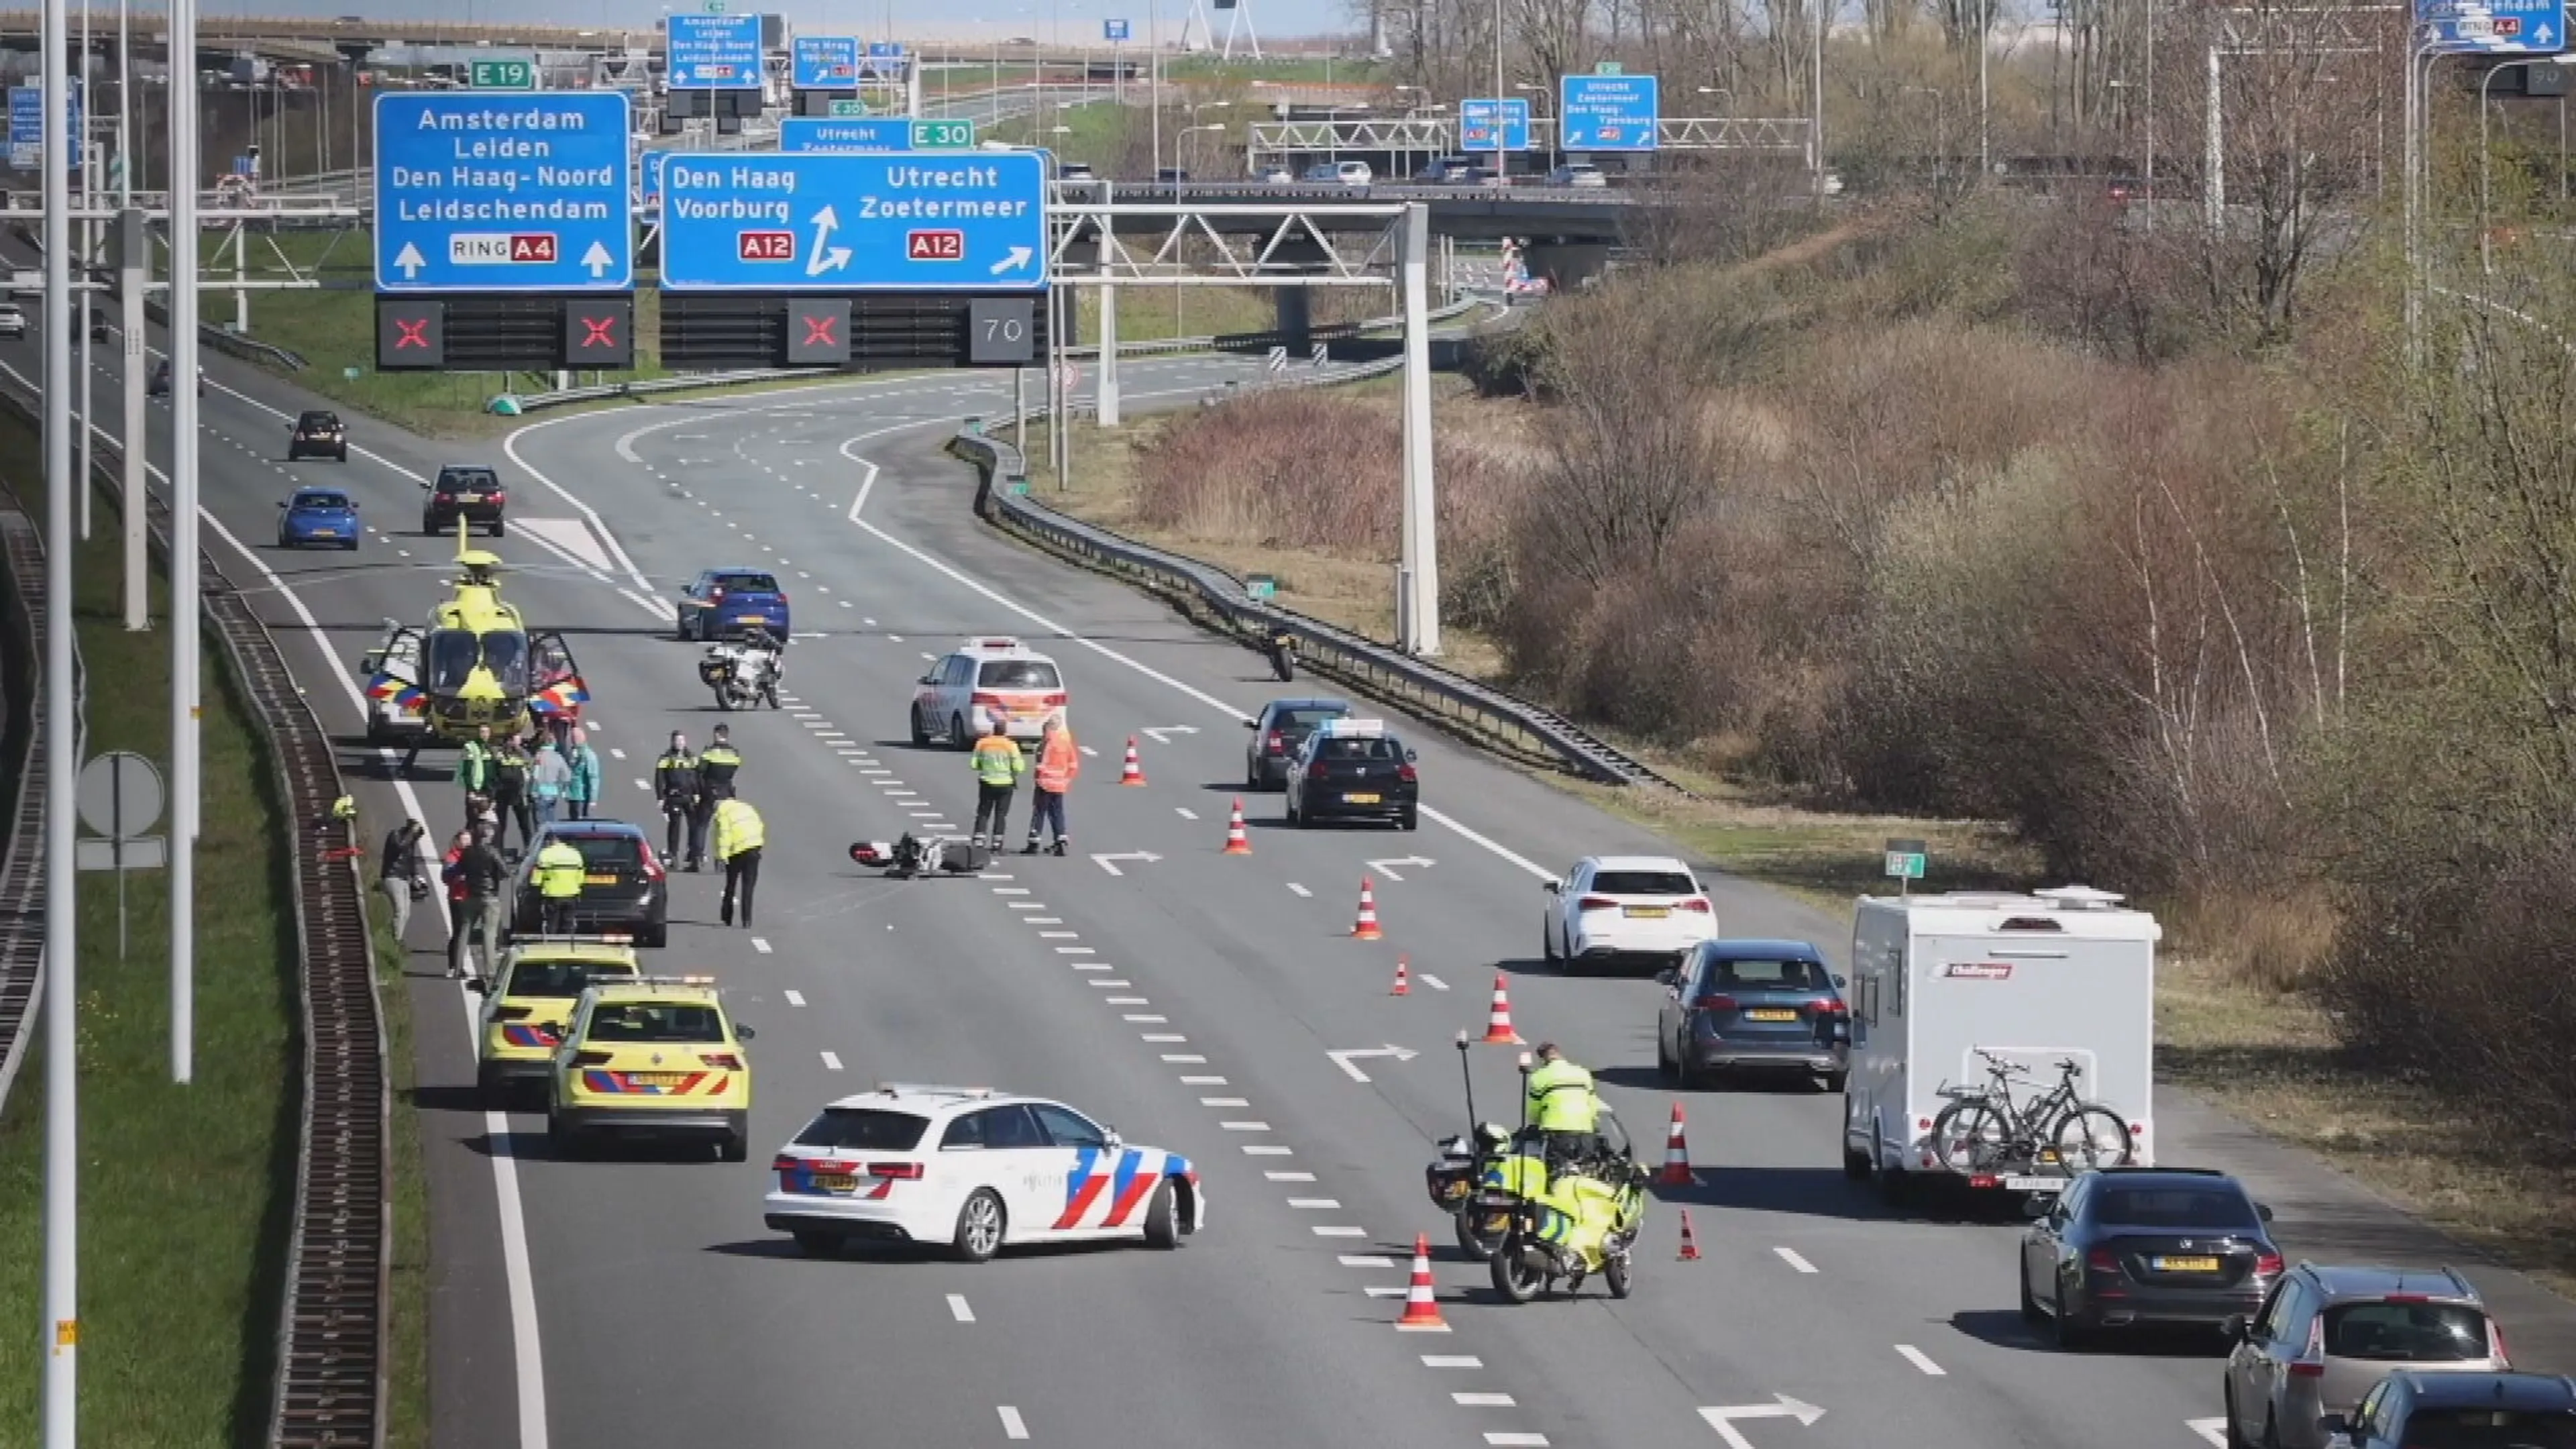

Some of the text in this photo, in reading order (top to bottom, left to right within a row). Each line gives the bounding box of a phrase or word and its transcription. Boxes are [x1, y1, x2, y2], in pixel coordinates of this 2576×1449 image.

[2496, 21, 2516, 32] A4
[478, 64, 523, 84] E 19
[419, 108, 584, 129] Amsterdam
[817, 128, 875, 140] Utrecht
[914, 126, 968, 144] E 30
[455, 138, 549, 157] Leiden
[393, 166, 441, 187] Den
[674, 168, 721, 189] Den
[732, 168, 796, 194] Haag
[888, 167, 998, 188] Utrecht
[400, 199, 608, 221] Leidschendam
[674, 199, 790, 222] Voorburg
[860, 197, 1027, 217] Zoetermeer
[454, 239, 551, 258] RING A4
[744, 237, 789, 256] A12
[912, 235, 957, 254] A12
[983, 319, 1022, 341] 70
